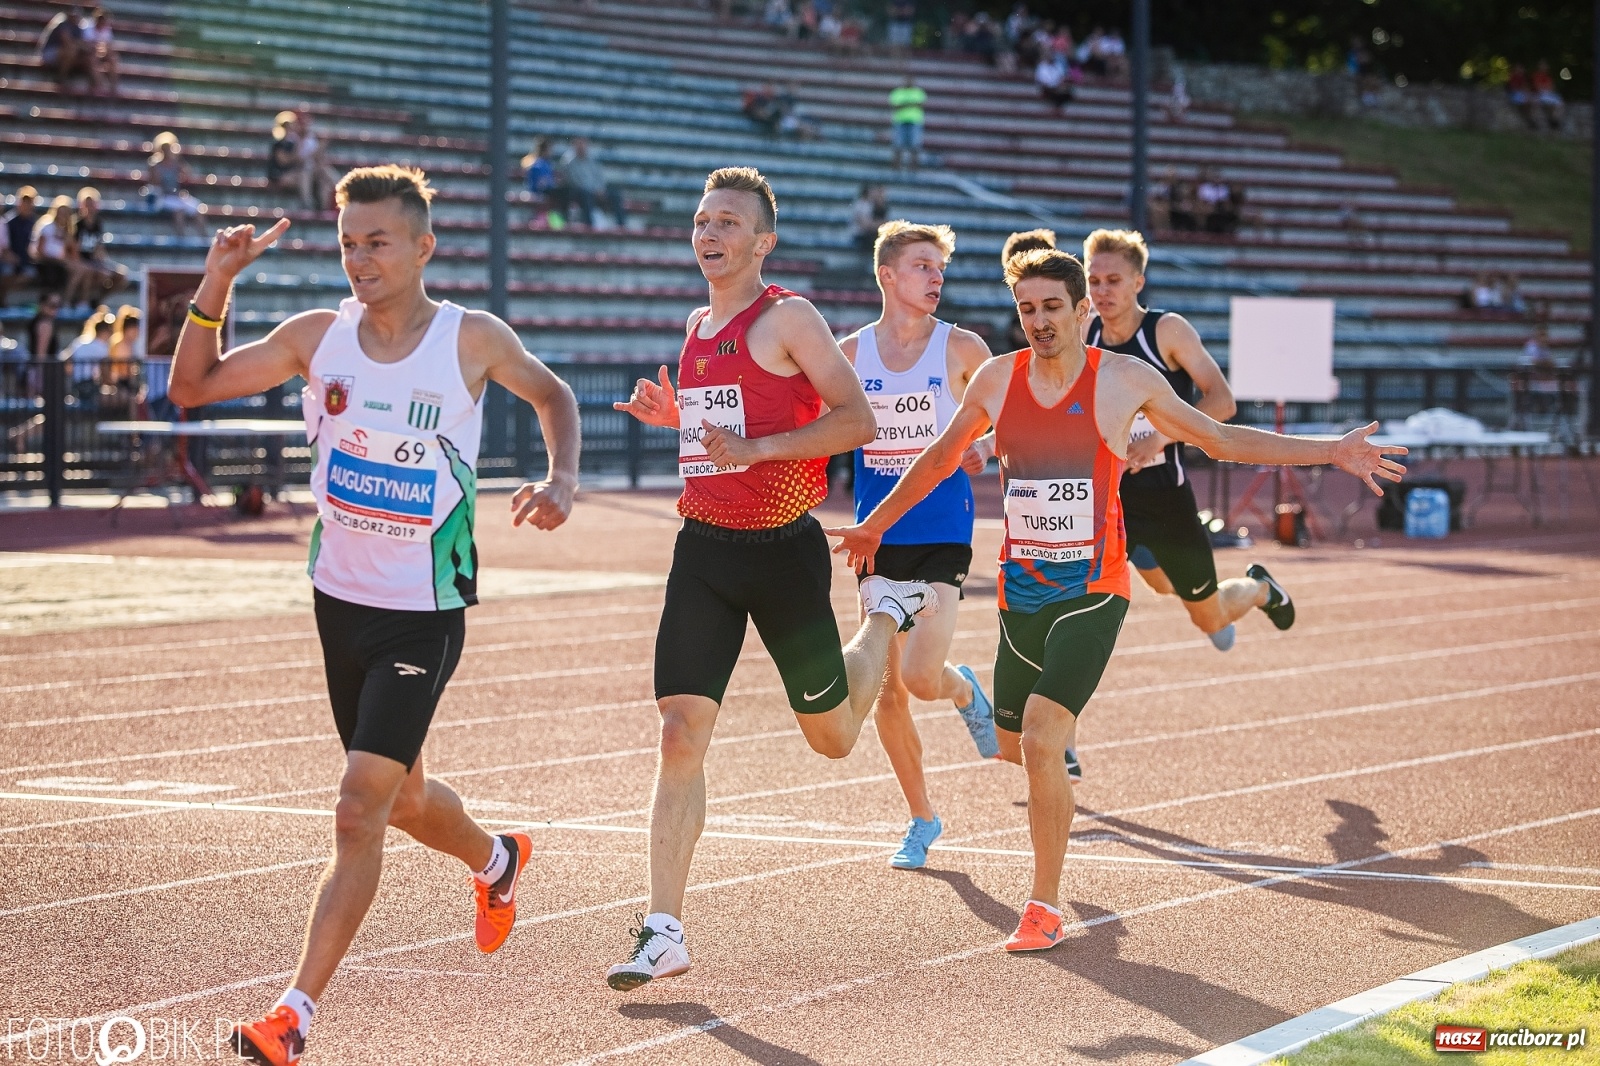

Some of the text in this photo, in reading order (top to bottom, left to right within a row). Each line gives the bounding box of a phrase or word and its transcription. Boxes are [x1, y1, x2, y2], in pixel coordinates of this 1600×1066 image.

[864, 379, 883, 391] ZS
[704, 389, 738, 410] 548
[895, 395, 931, 413] 606
[875, 424, 935, 440] ZYBYLAK
[394, 441, 425, 464] 69
[683, 463, 714, 475] RACIBÓRZ
[330, 465, 432, 504] AUGUSTYNIAK
[1048, 482, 1089, 501] 285
[1022, 515, 1074, 531] TURSKI
[387, 525, 416, 538] 2019
[1020, 548, 1082, 560] RACIBÓRZ 2019
